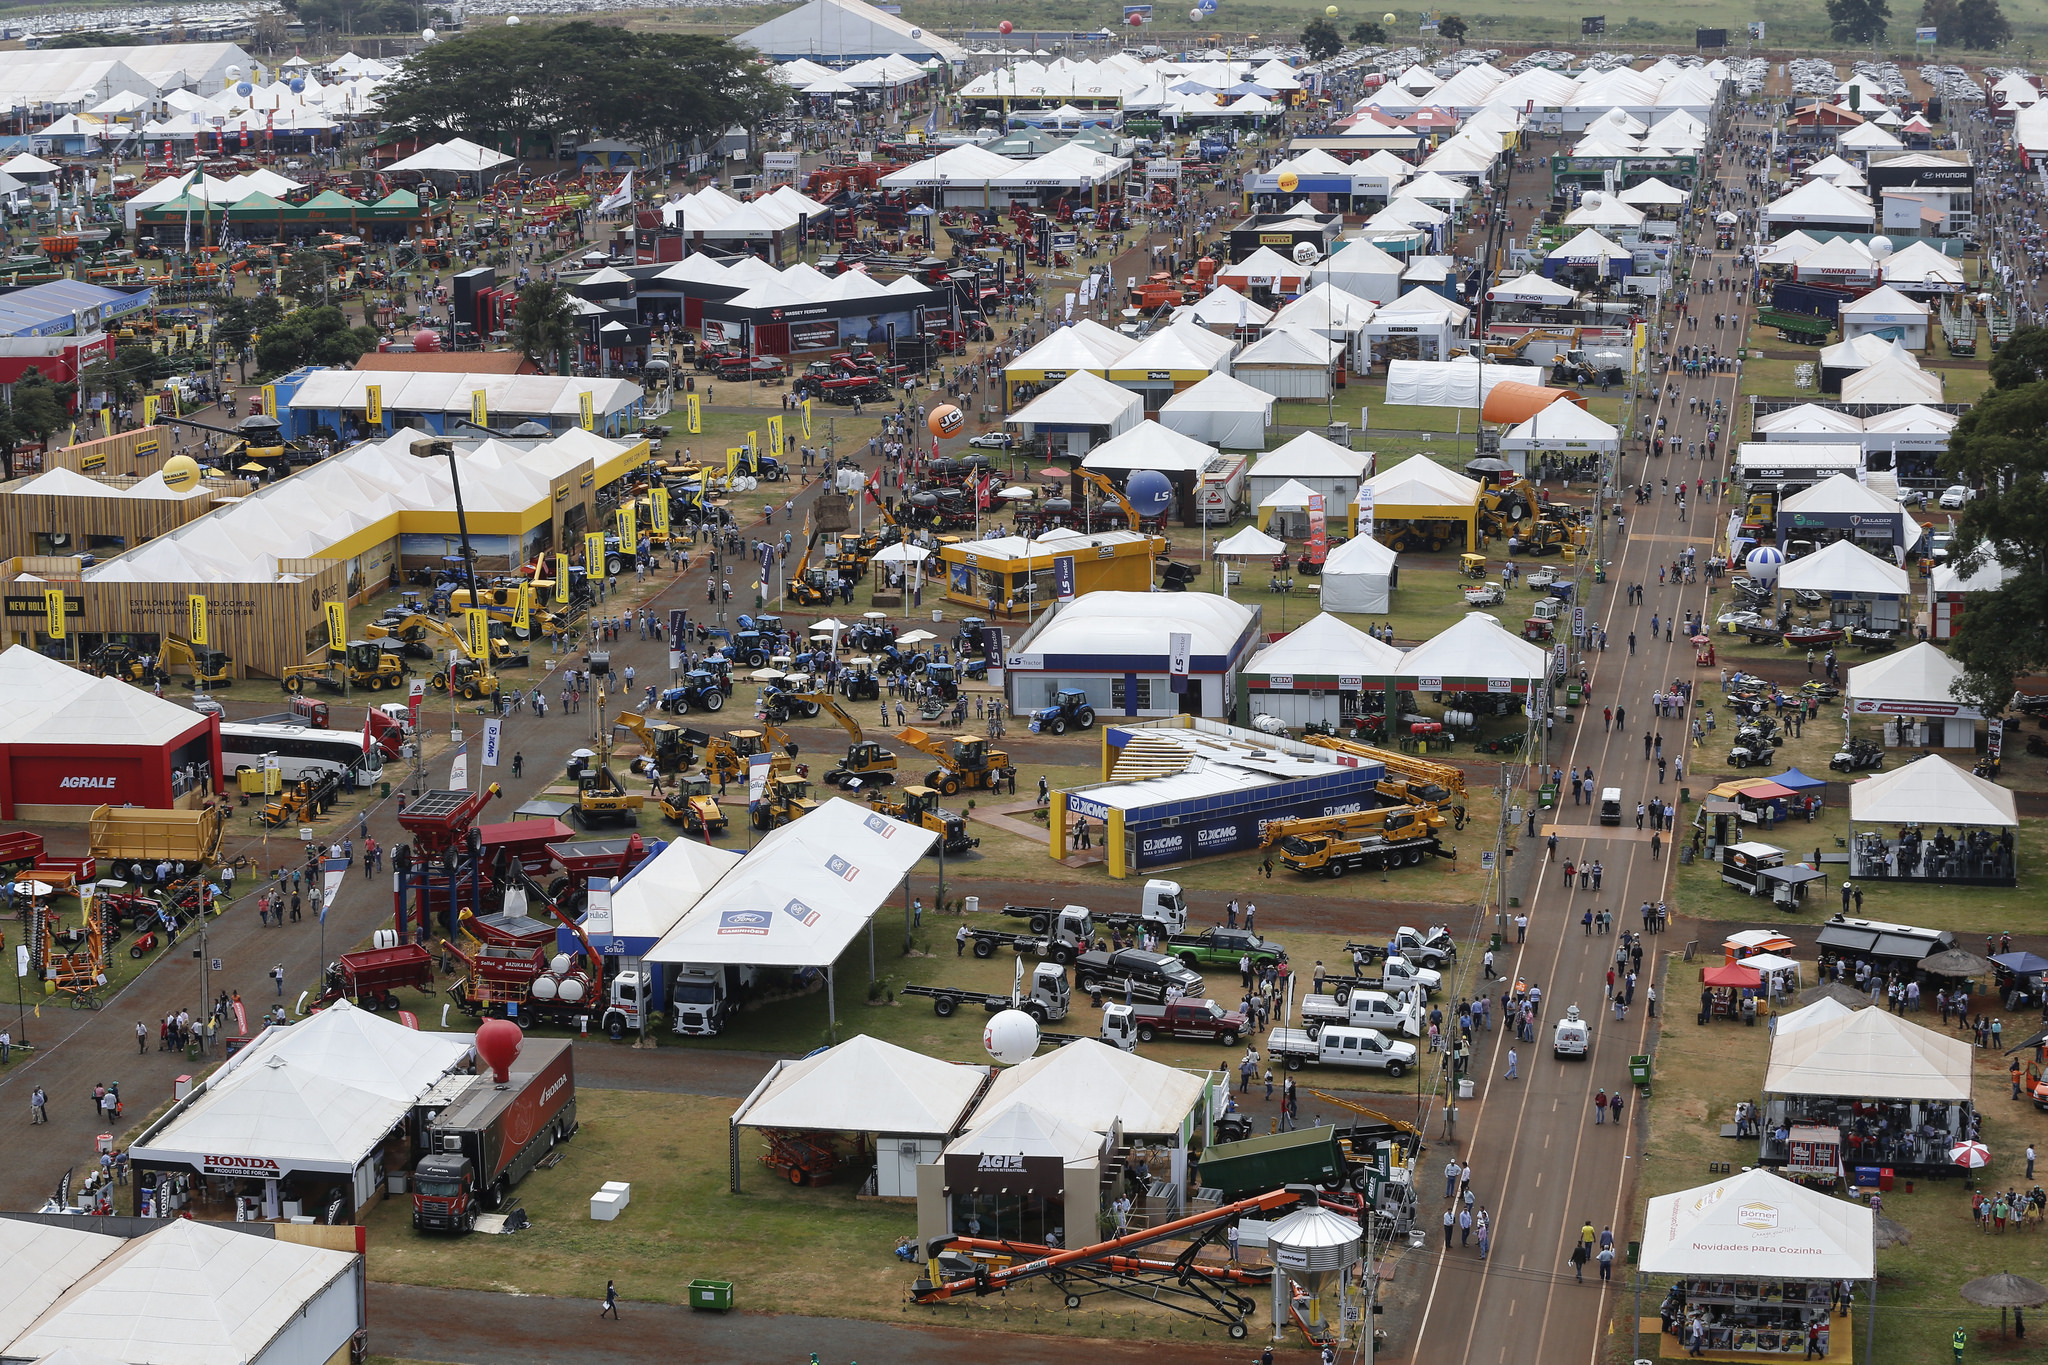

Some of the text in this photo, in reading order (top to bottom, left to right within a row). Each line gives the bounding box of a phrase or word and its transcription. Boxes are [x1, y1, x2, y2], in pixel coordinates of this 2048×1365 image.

[1154, 490, 1169, 502] LS
[966, 553, 978, 561] JCB
[1062, 560, 1071, 594] LS Tractor
[321, 583, 338, 602] STORE
[9, 602, 26, 611] NEW
[1574, 608, 1584, 633] KBM
[991, 651, 1000, 666] LS
[1175, 636, 1186, 672] LS Tractor
[1008, 657, 1022, 665] LS
[1270, 676, 1293, 685] KBM
[1339, 677, 1362, 686] KBM
[1419, 678, 1441, 687] KBM
[1488, 679, 1511, 688] KBM
[60, 777, 116, 789] AGRALE
[1079, 799, 1109, 820] XCMG
[1207, 825, 1237, 841] XCMG
[1153, 835, 1183, 848] XCMG
[729, 913, 764, 924] Ford
[604, 945, 625, 954] Sollus
[545, 1073, 568, 1102] HONDA
[203, 1155, 280, 1170] HONDA
[978, 1155, 1010, 1168] AGI
[214, 1168, 243, 1176] PRODUTOS
[1740, 1210, 1777, 1220] Börner
[1692, 1242, 1822, 1255] Novidades para Cozinha
